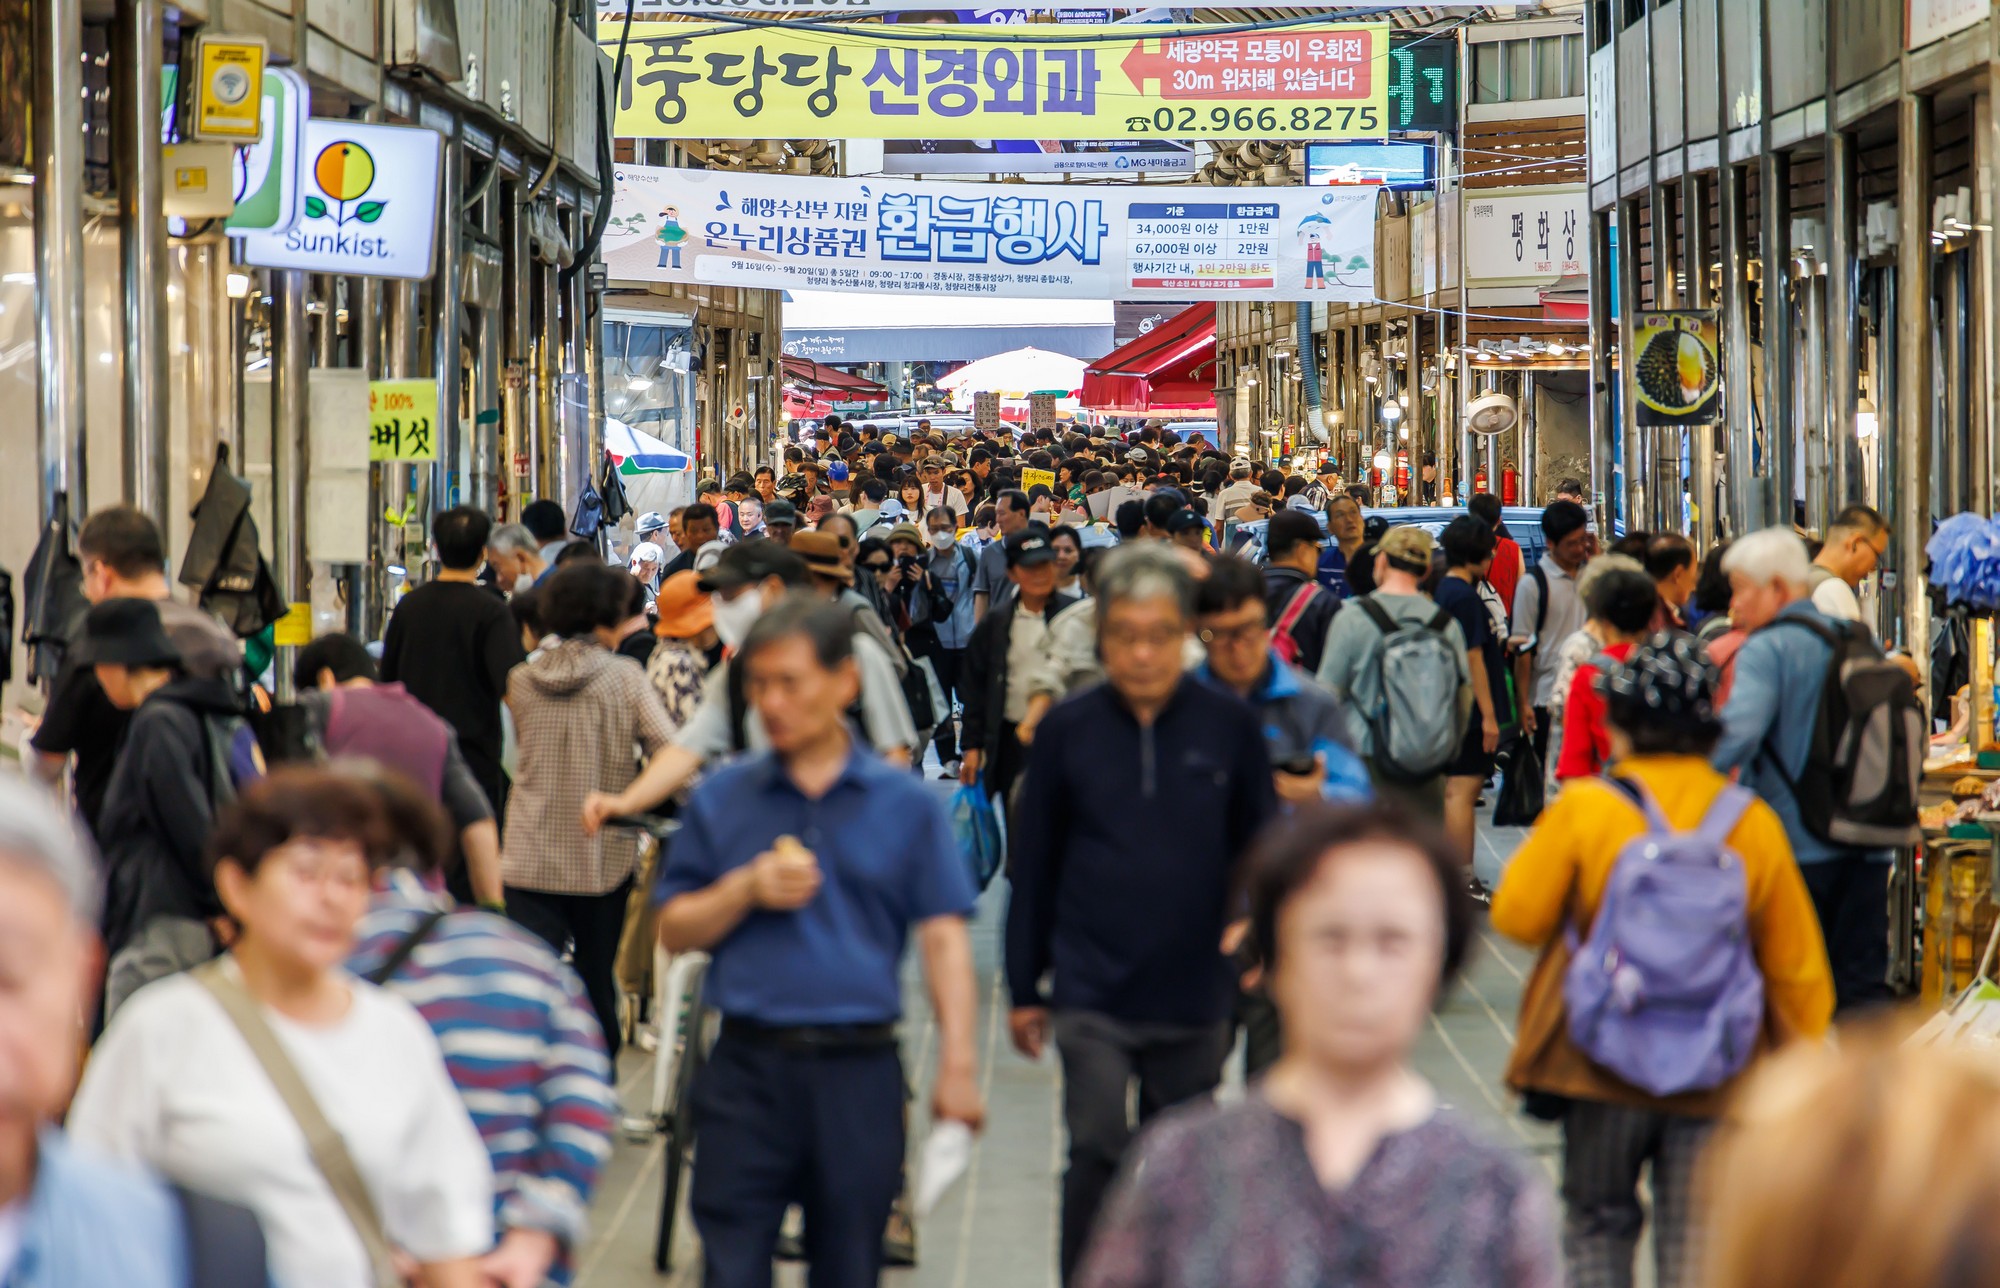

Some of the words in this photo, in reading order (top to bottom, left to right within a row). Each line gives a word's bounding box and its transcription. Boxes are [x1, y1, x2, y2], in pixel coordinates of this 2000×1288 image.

[1166, 40, 1239, 63] 세광약국
[1245, 39, 1300, 62] 모퉁이
[1306, 38, 1362, 62] 우회전
[861, 48, 1102, 118] 신경외과
[1172, 69, 1214, 91] 30m
[1221, 68, 1275, 92] 위치해
[1282, 67, 1355, 92] 있습니다
[1153, 106, 1378, 132] 02.966.8275
[1147, 159, 1187, 168] 새마을금고
[628, 174, 659, 182] 해양수산부
[741, 197, 829, 219] 해양수산부
[834, 201, 868, 221] 지원
[1165, 206, 1185, 217] 기준
[1236, 206, 1274, 216] 환급금액
[876, 192, 1109, 266] 환급행사
[1136, 223, 1191, 235] 34,000원
[1195, 223, 1219, 234] 이상
[1238, 222, 1270, 234] 1만원
[703, 221, 867, 259] 온누리상품권
[1237, 242, 1269, 255] 2만원
[1135, 242, 1190, 256] 67,000원
[1193, 242, 1217, 254] 이상
[731, 261, 744, 270] 9월
[745, 262, 776, 272] 16일(수)
[783, 265, 796, 274] 9월
[797, 266, 829, 276] 20일(일)
[839, 269, 859, 278] 5일간
[869, 270, 893, 279] 09:00
[900, 271, 923, 280] 17:00
[933, 272, 966, 282] 경동시장,
[1016, 274, 1039, 283] 청량리
[1040, 275, 1073, 285] 종합시장,
[1132, 262, 1177, 274] 행사기간
[1179, 262, 1195, 275] 내,
[1198, 263, 1216, 273] 1인
[1219, 263, 1247, 274] 2만원
[1250, 263, 1271, 273] 한도
[806, 276, 829, 285] 청량리
[830, 277, 877, 288] 농수산물시장,
[879, 279, 901, 289] 청량리
[903, 280, 943, 291] 청과물시장,
[944, 282, 997, 292] 청량리전통시장
[383, 393, 414, 411] 100%
[369, 416, 430, 457] 버섯
